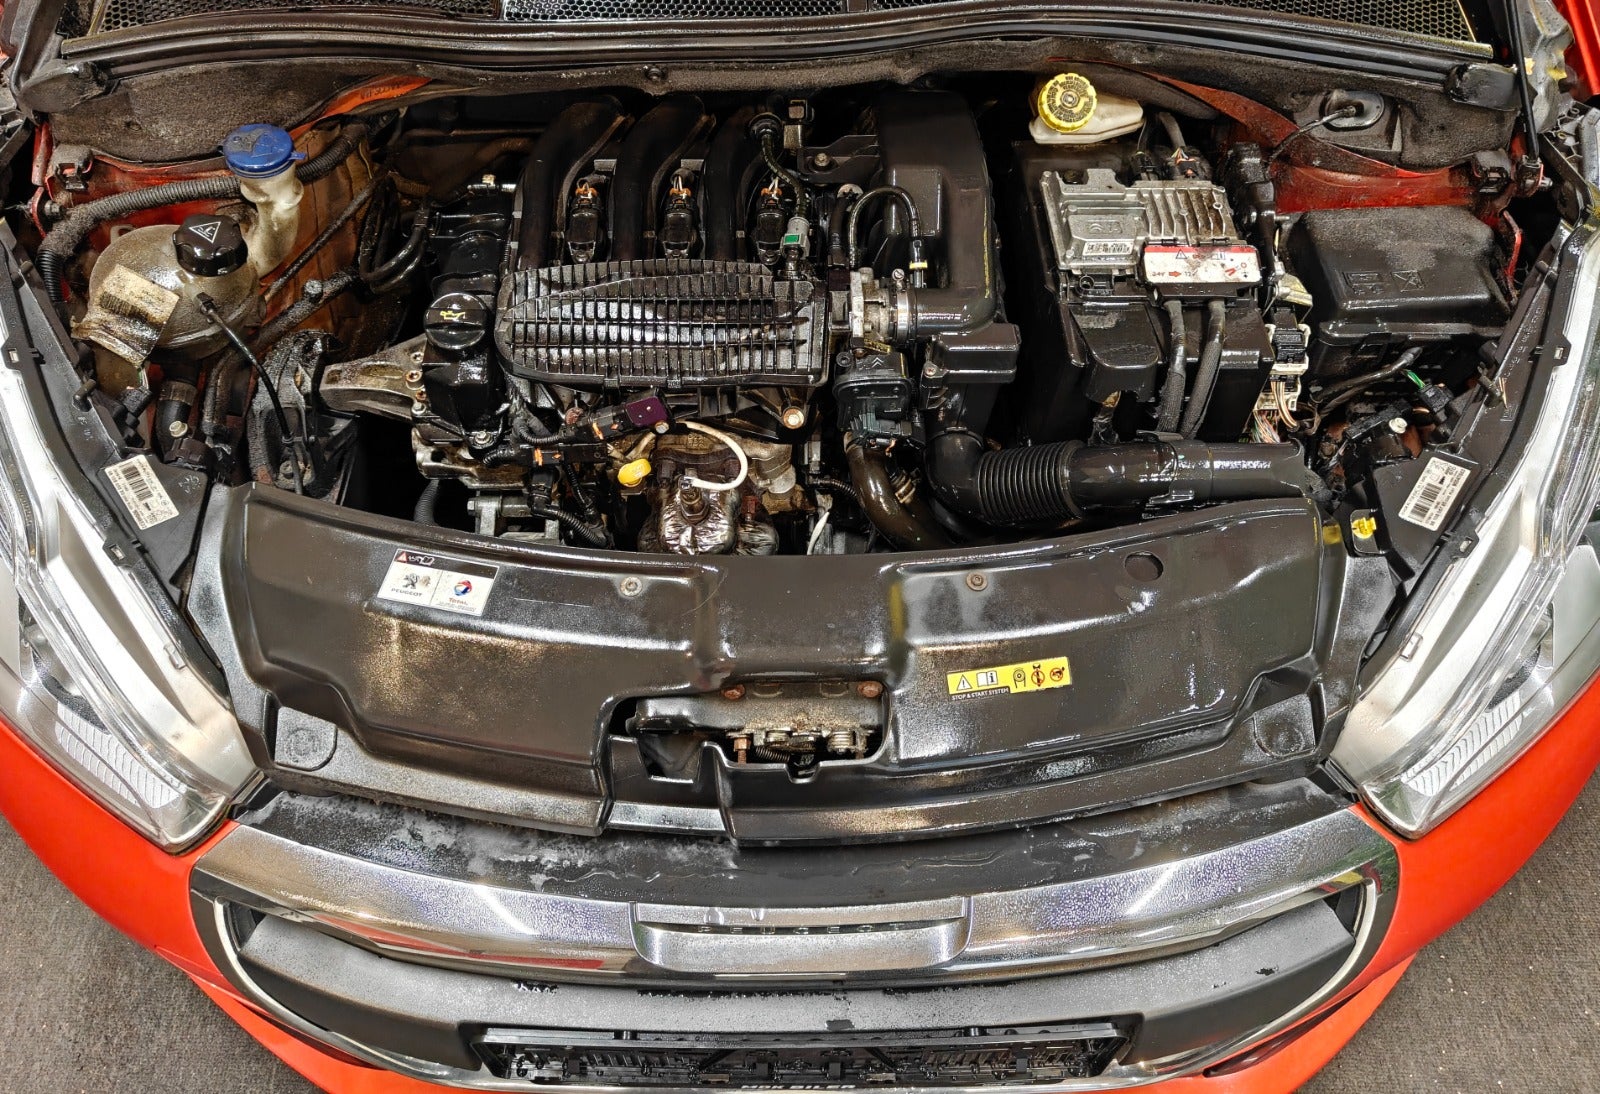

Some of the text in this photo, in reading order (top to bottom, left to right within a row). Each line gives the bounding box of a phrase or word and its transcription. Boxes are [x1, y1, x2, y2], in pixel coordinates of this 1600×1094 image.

[391, 587, 423, 597] PEUGEOT
[988, 687, 1009, 696] SYSTEM
[697, 922, 905, 935] PEUGEOT
